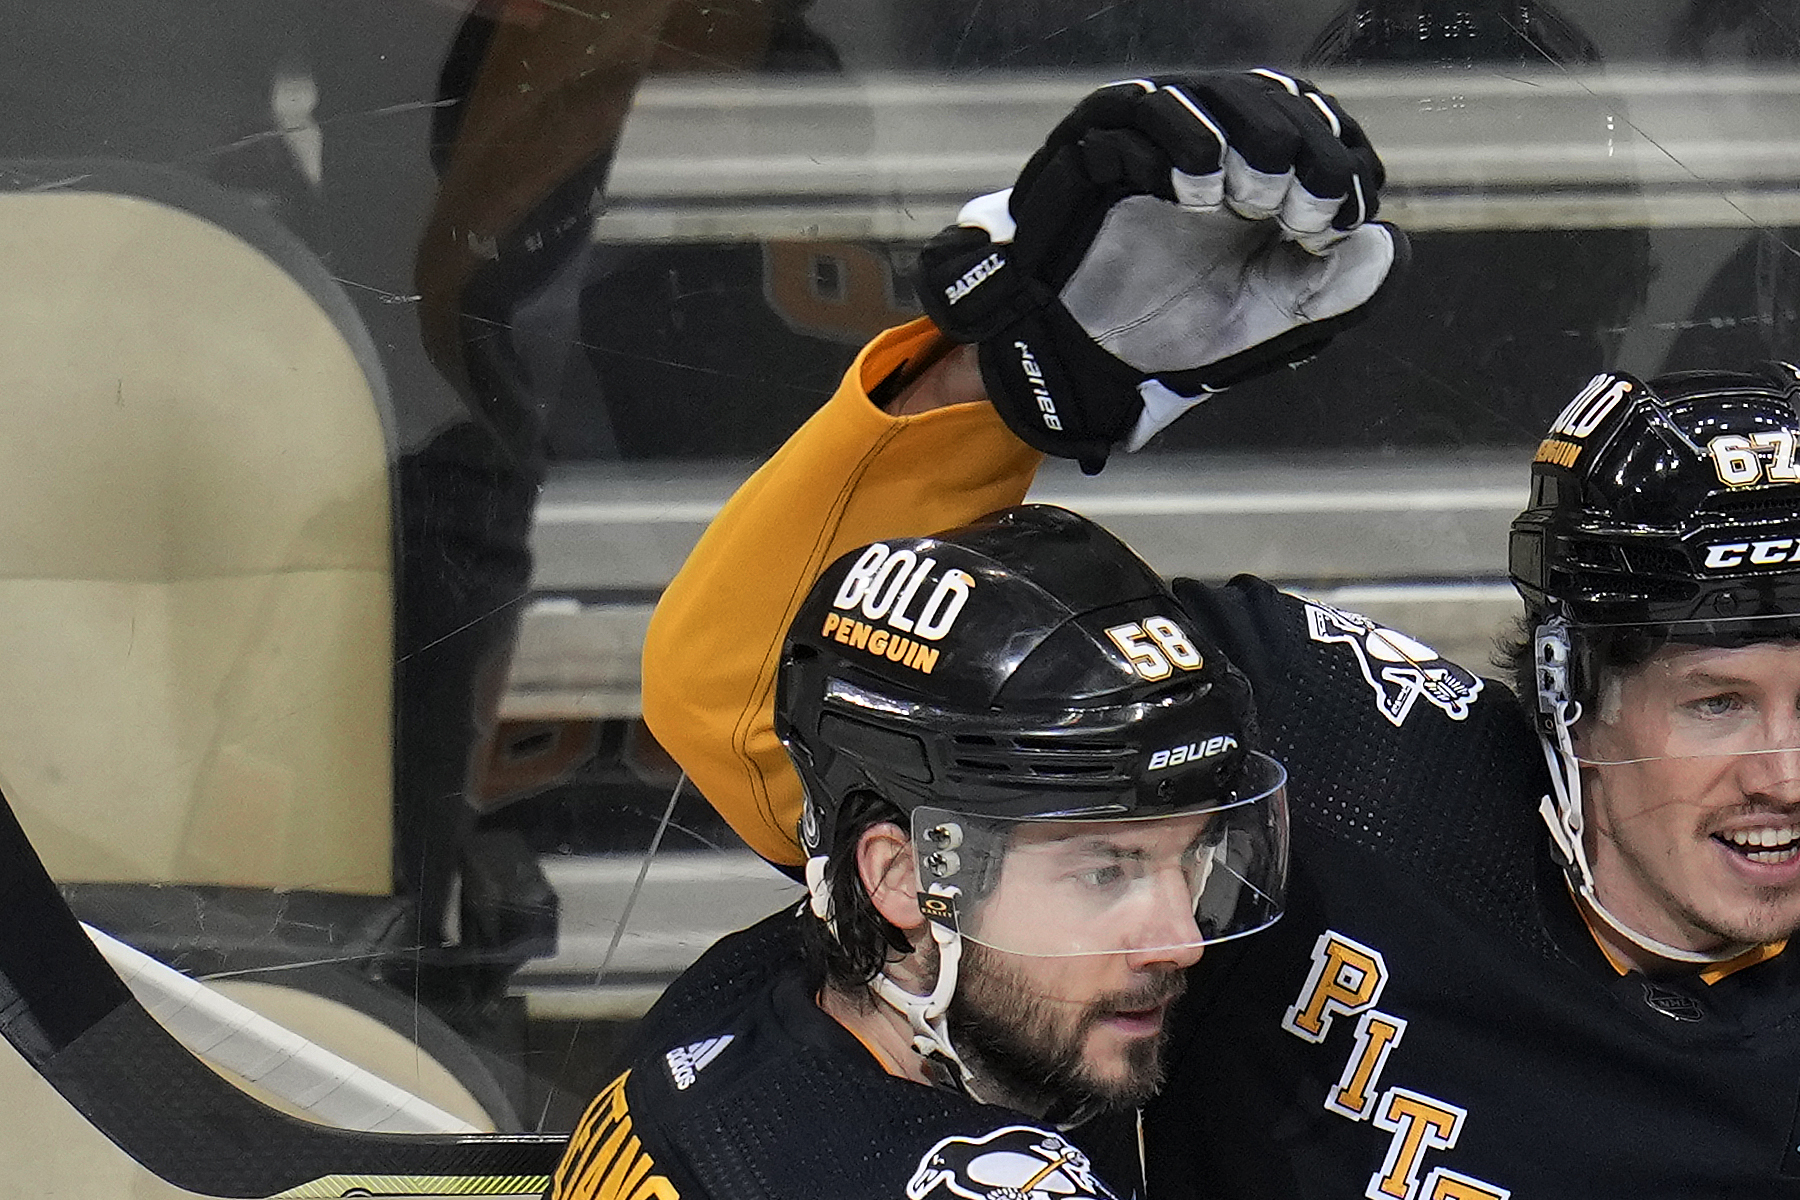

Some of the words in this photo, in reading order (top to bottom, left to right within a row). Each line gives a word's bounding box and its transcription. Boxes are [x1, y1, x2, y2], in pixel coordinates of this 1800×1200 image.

[832, 542, 977, 642] BOLD
[821, 611, 941, 675] PENGUIN
[1103, 614, 1204, 683] 58
